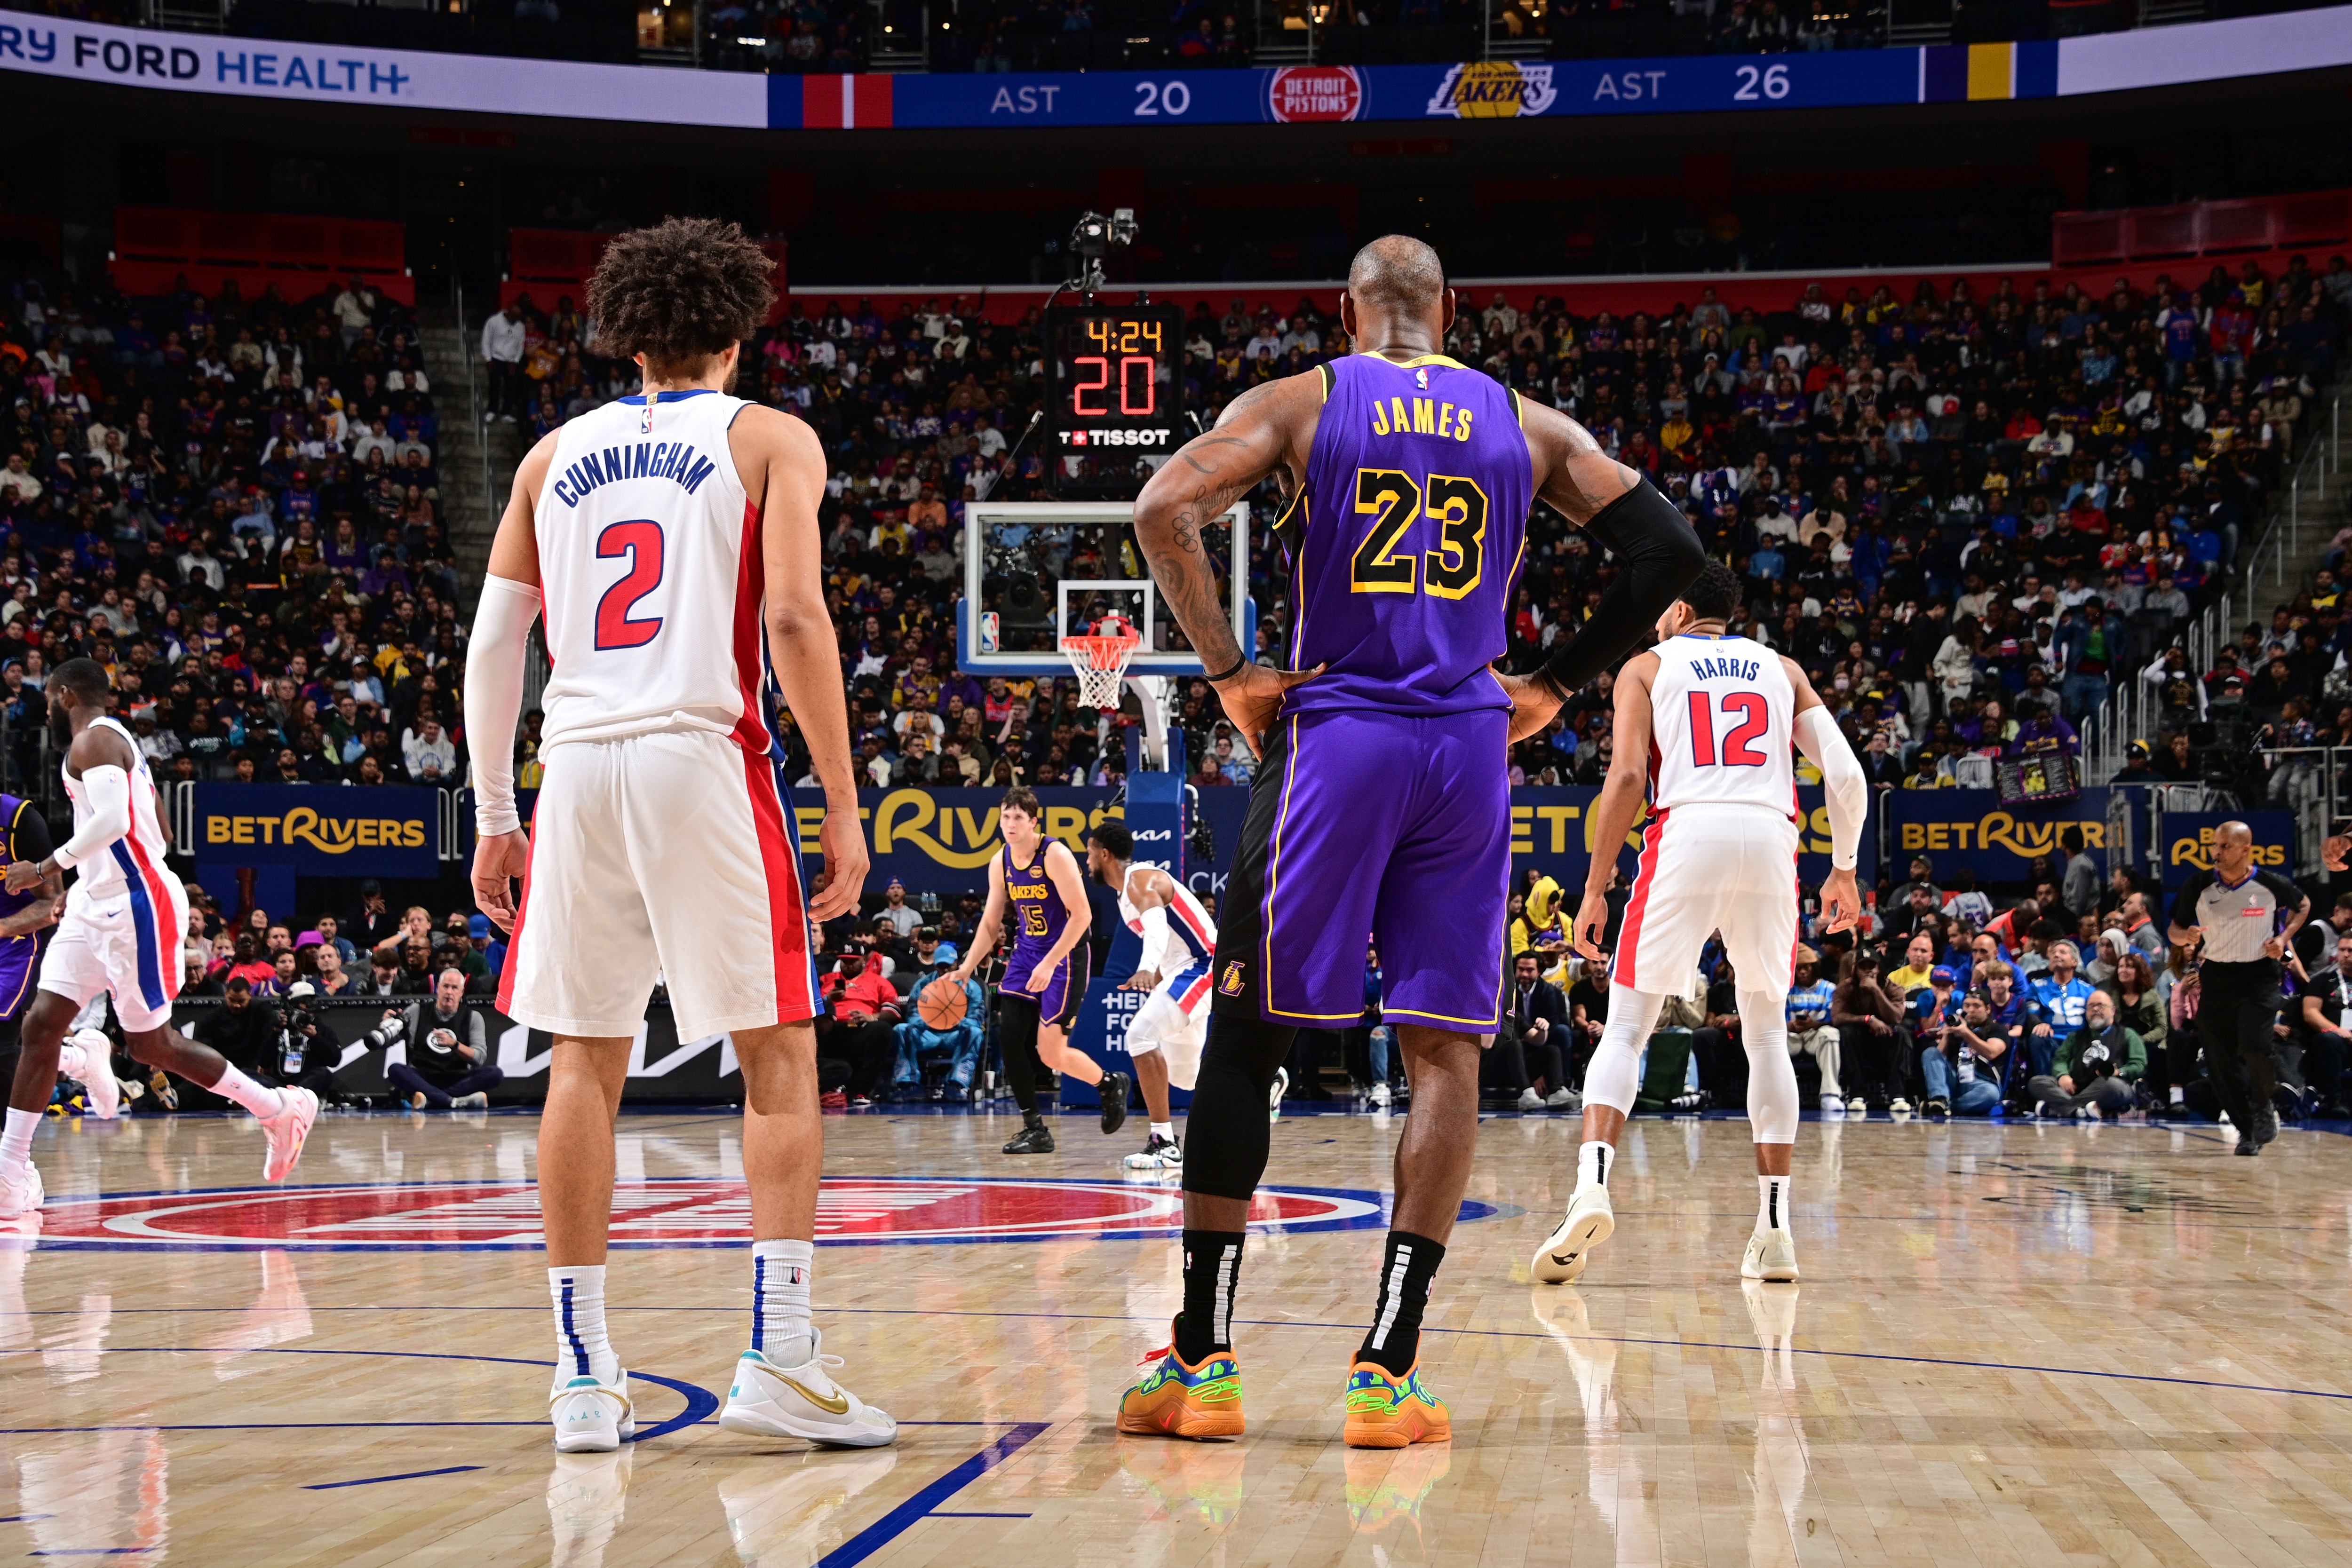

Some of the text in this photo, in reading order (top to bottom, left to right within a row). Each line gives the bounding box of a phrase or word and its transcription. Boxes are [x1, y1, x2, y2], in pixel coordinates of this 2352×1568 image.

[73, 34, 200, 80] FORD
[217, 50, 410, 95] HEALTH
[990, 86, 1059, 114] AST
[1134, 81, 1191, 116] 20
[1285, 77, 1346, 95] DETROIT
[1437, 72, 1548, 110] LAKERS
[1593, 70, 1667, 101] AST
[1733, 64, 1791, 101] 26
[1285, 96, 1347, 113] PISTONS
[1089, 322, 1161, 353] 4:24
[1074, 356, 1154, 415] 20
[1373, 396, 1473, 442] JAMES
[1089, 429, 1170, 446] TISSOT
[554, 442, 716, 508] CUNNINGHAM
[1351, 468, 1489, 600] 23
[594, 519, 665, 651] 2
[1690, 657, 1760, 681] HARRIS
[1687, 691, 1769, 768] 12
[1007, 882, 1049, 901] LAKERS
[1019, 904, 1048, 936] 15
